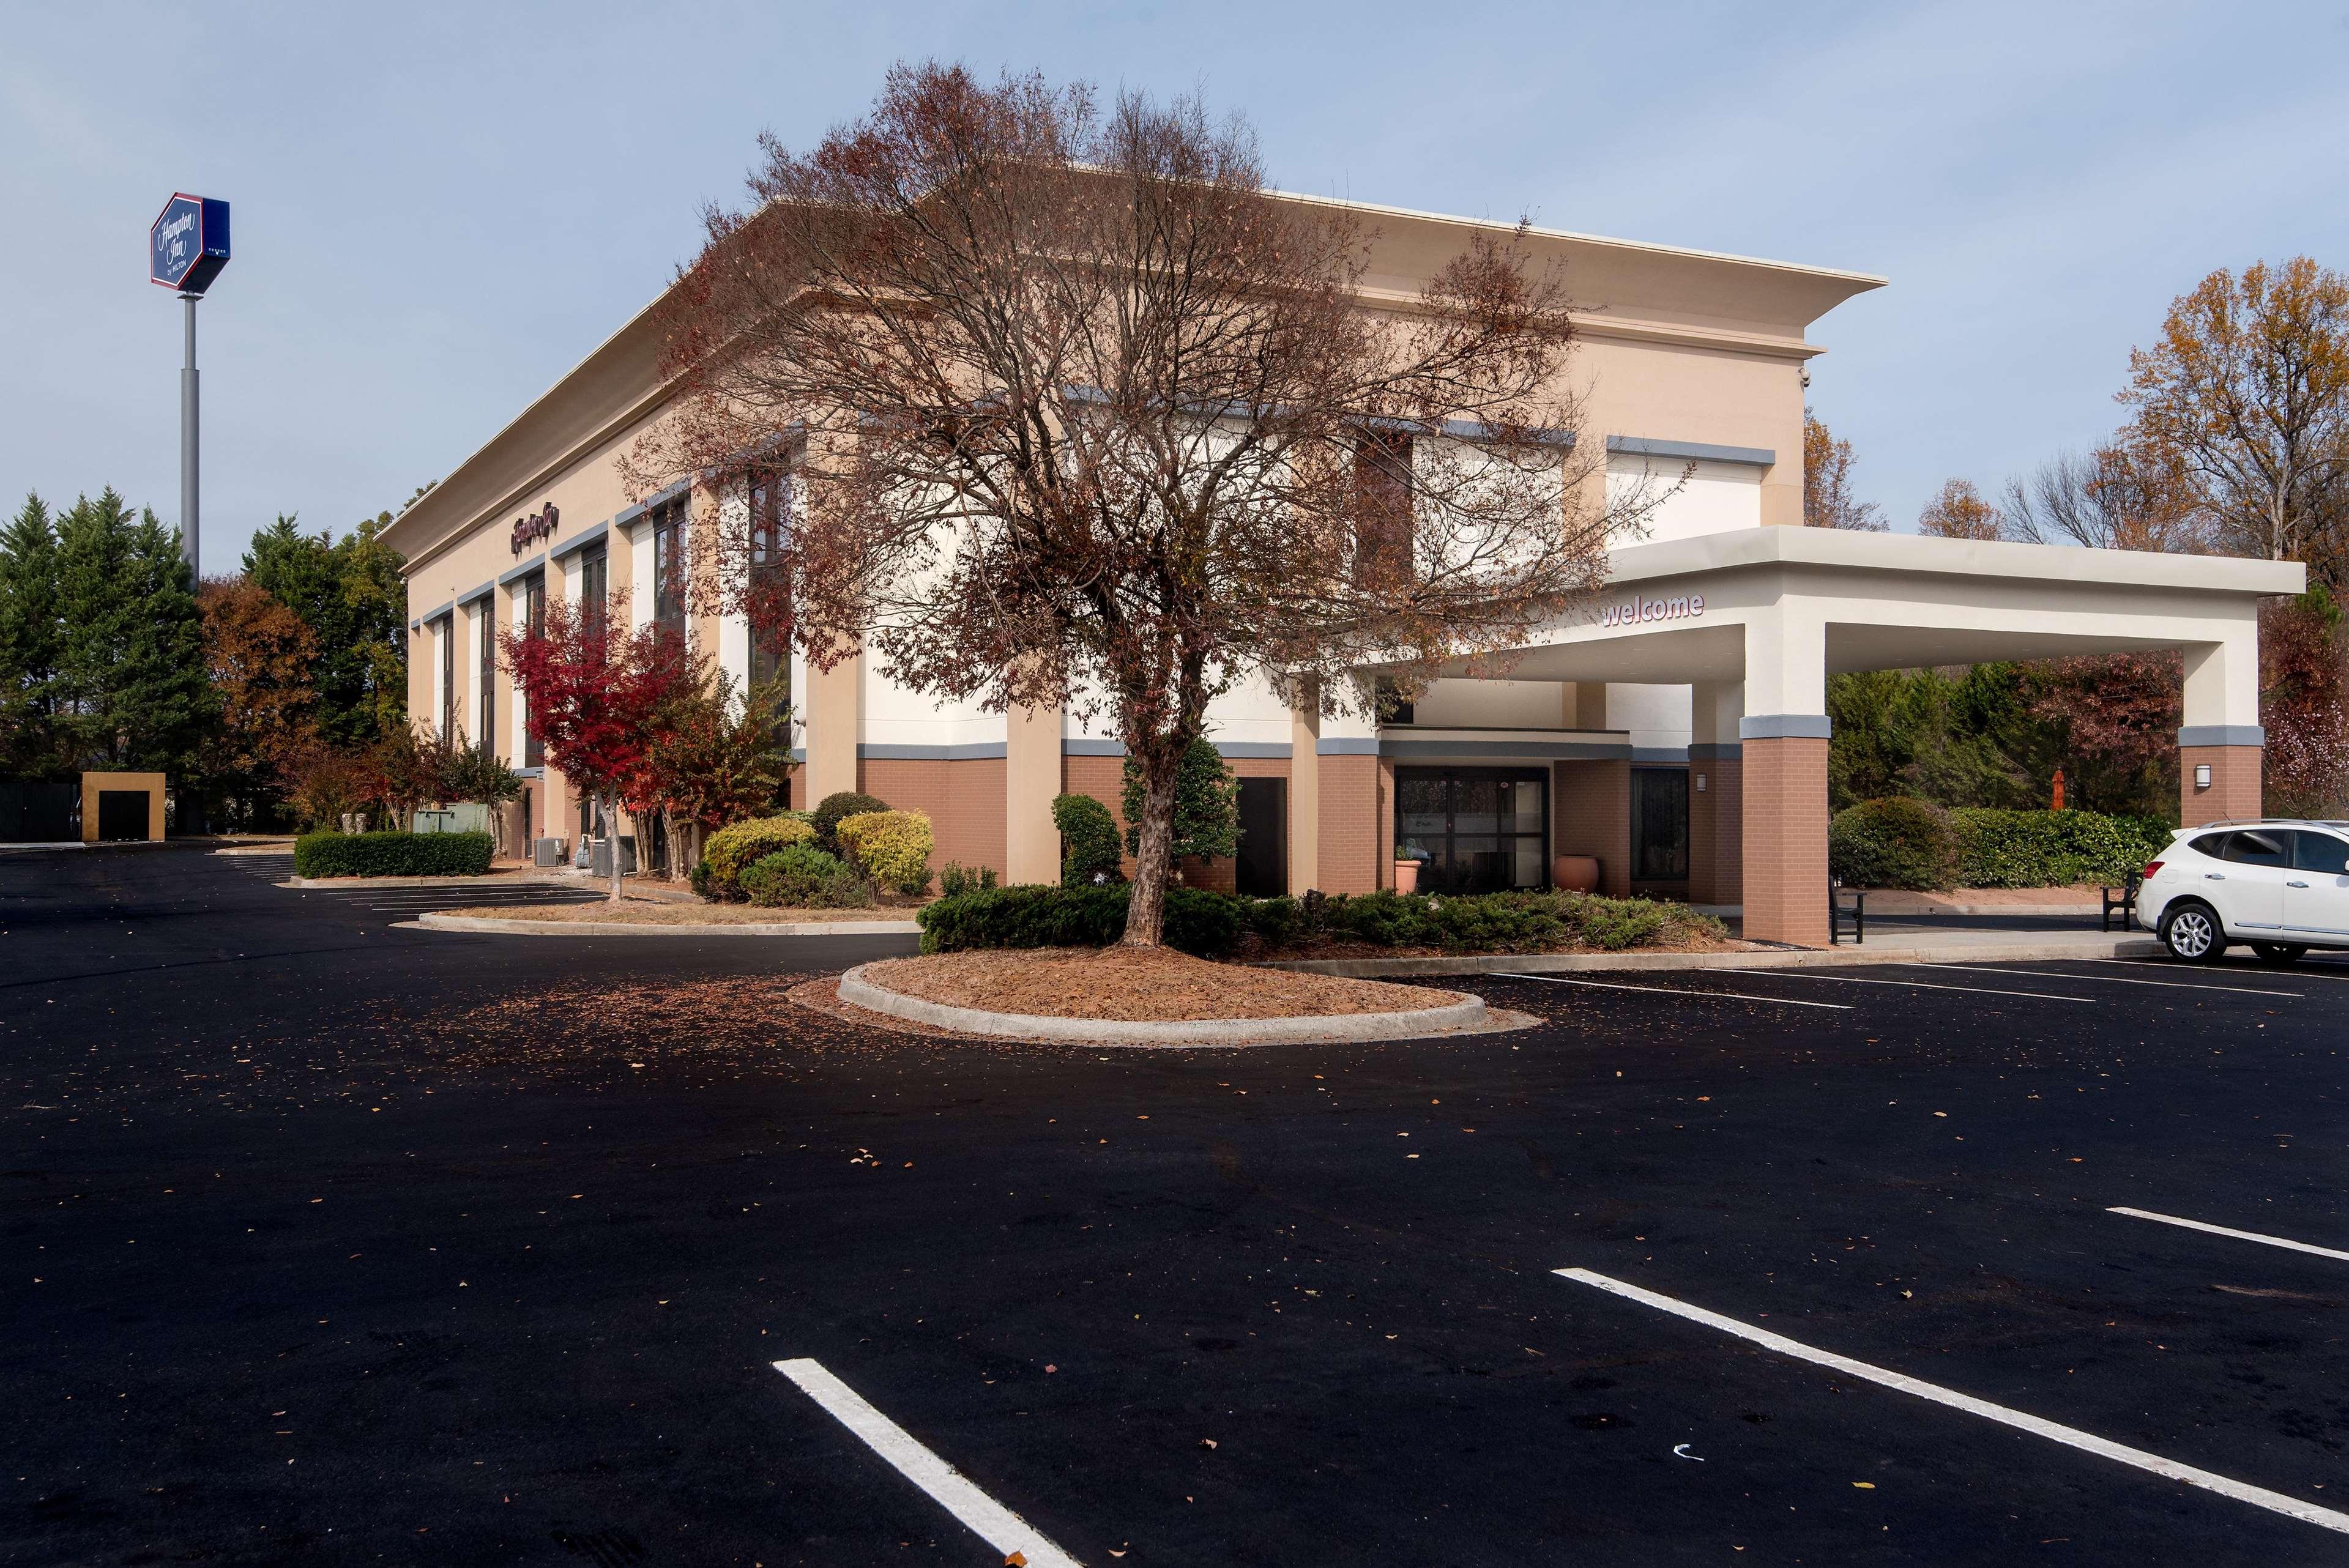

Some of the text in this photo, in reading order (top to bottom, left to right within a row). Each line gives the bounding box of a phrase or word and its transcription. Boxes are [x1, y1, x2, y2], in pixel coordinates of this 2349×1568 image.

[158, 212, 195, 251] Hampton
[166, 237, 187, 266] Inn
[172, 259, 187, 273] HILTON
[1601, 595, 1705, 626] welcome
